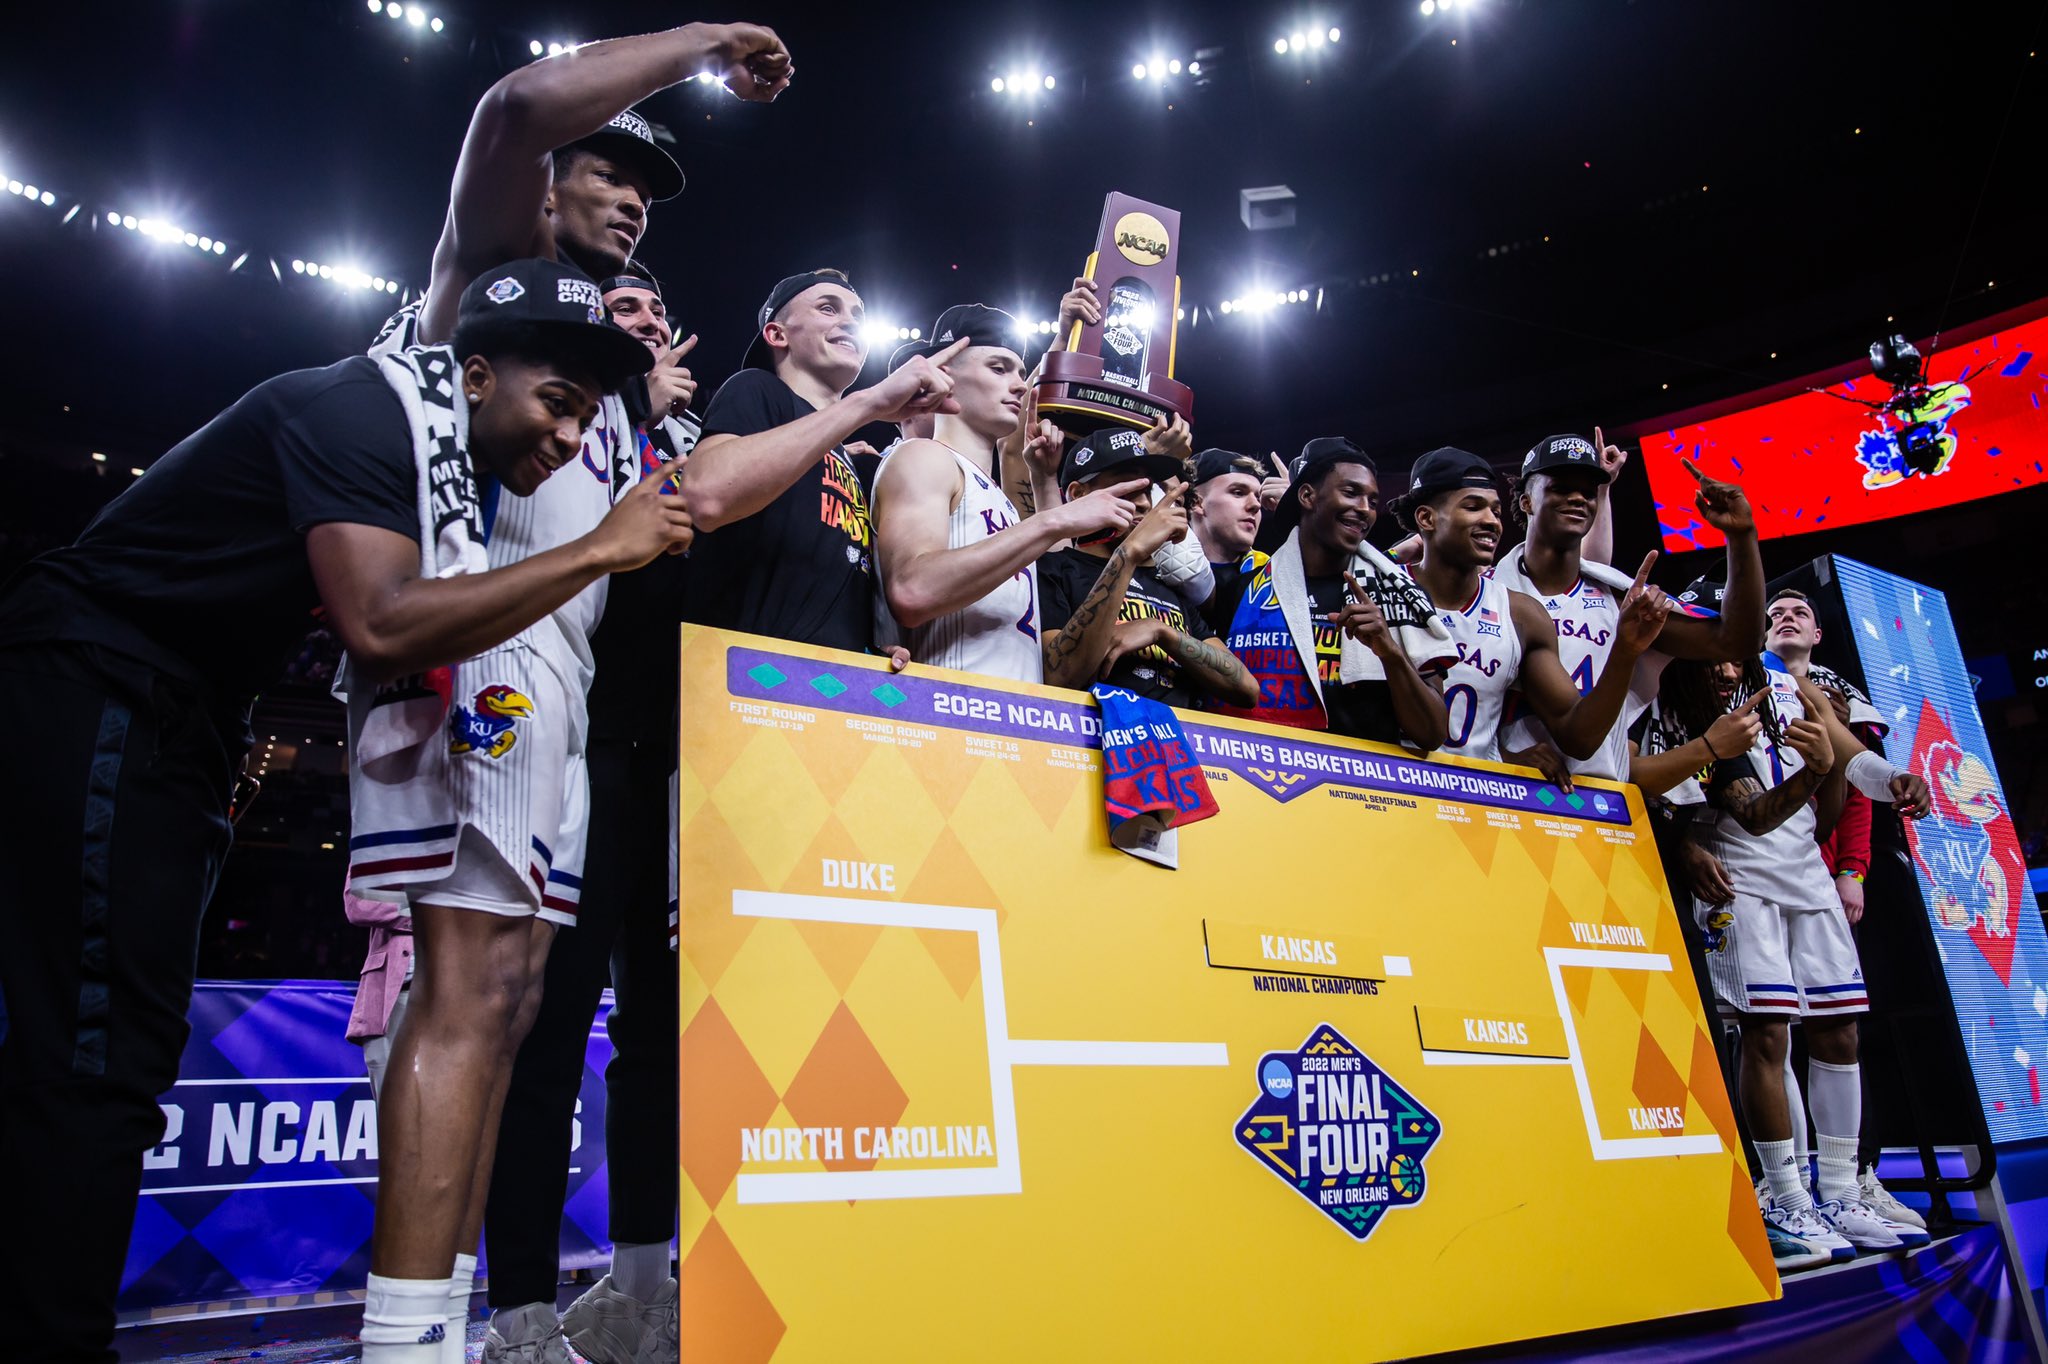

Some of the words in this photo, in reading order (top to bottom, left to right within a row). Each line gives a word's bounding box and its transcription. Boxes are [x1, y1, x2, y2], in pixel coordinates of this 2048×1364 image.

[1117, 231, 1167, 260] NCAA
[1113, 338, 1132, 349] FOUR
[1115, 331, 1134, 342] FINAL
[1077, 388, 1120, 406] NATIONAL
[729, 702, 769, 717] FIRST
[772, 707, 816, 723] ROUND
[469, 720, 493, 737] KU
[742, 716, 777, 728] MARCH
[845, 718, 894, 734] SECOND
[896, 726, 937, 741] ROUND
[863, 733, 896, 744] MARCH
[933, 692, 1002, 722] 2022
[1007, 704, 1075, 733] NCAA
[1193, 733, 1206, 753] I
[1209, 736, 1275, 763] MEN'S
[1278, 747, 1396, 782] BASKETBALL
[1397, 766, 1528, 801] CHAMPIONSHIP
[965, 736, 1003, 750] SWEET
[1005, 742, 1019, 752] 16
[965, 747, 995, 758] MARCH
[1051, 748, 1080, 760] ELITE
[1083, 752, 1090, 762] 8
[1046, 758, 1075, 769] MARCH
[1328, 789, 1369, 802] NATIONAL
[1369, 794, 1418, 809] SEMIFINALS
[1364, 803, 1382, 812] APRIL
[1437, 804, 1458, 815] ELITE
[1459, 807, 1465, 815] 8
[1485, 811, 1509, 821] SWEET
[1534, 819, 1561, 830] SECOND
[1561, 822, 1583, 832] ROUND
[1596, 827, 1614, 837] FIRST
[1615, 830, 1636, 840] ROUND
[821, 858, 896, 893] DUKE
[1569, 921, 1646, 947] VILLANOVA
[1260, 934, 1337, 965] KANSAS
[1253, 975, 1310, 993] NATIONAL
[1311, 977, 1379, 995] CHAMPIONS
[1463, 1018, 1529, 1046] KANSAS
[1302, 1057, 1329, 1072] 2022
[1331, 1056, 1361, 1071] MEN'S
[1267, 1077, 1293, 1089] NCAA
[1297, 1073, 1390, 1122] FINAL
[1627, 1106, 1685, 1132] KANSAS
[207, 1100, 379, 1167] NCAA
[741, 1126, 844, 1162] NORTH
[853, 1125, 994, 1160] CAROLINA
[1299, 1122, 1390, 1177] FOUR
[1320, 1188, 1343, 1206] NEW
[1345, 1186, 1389, 1204] ORLEANS
